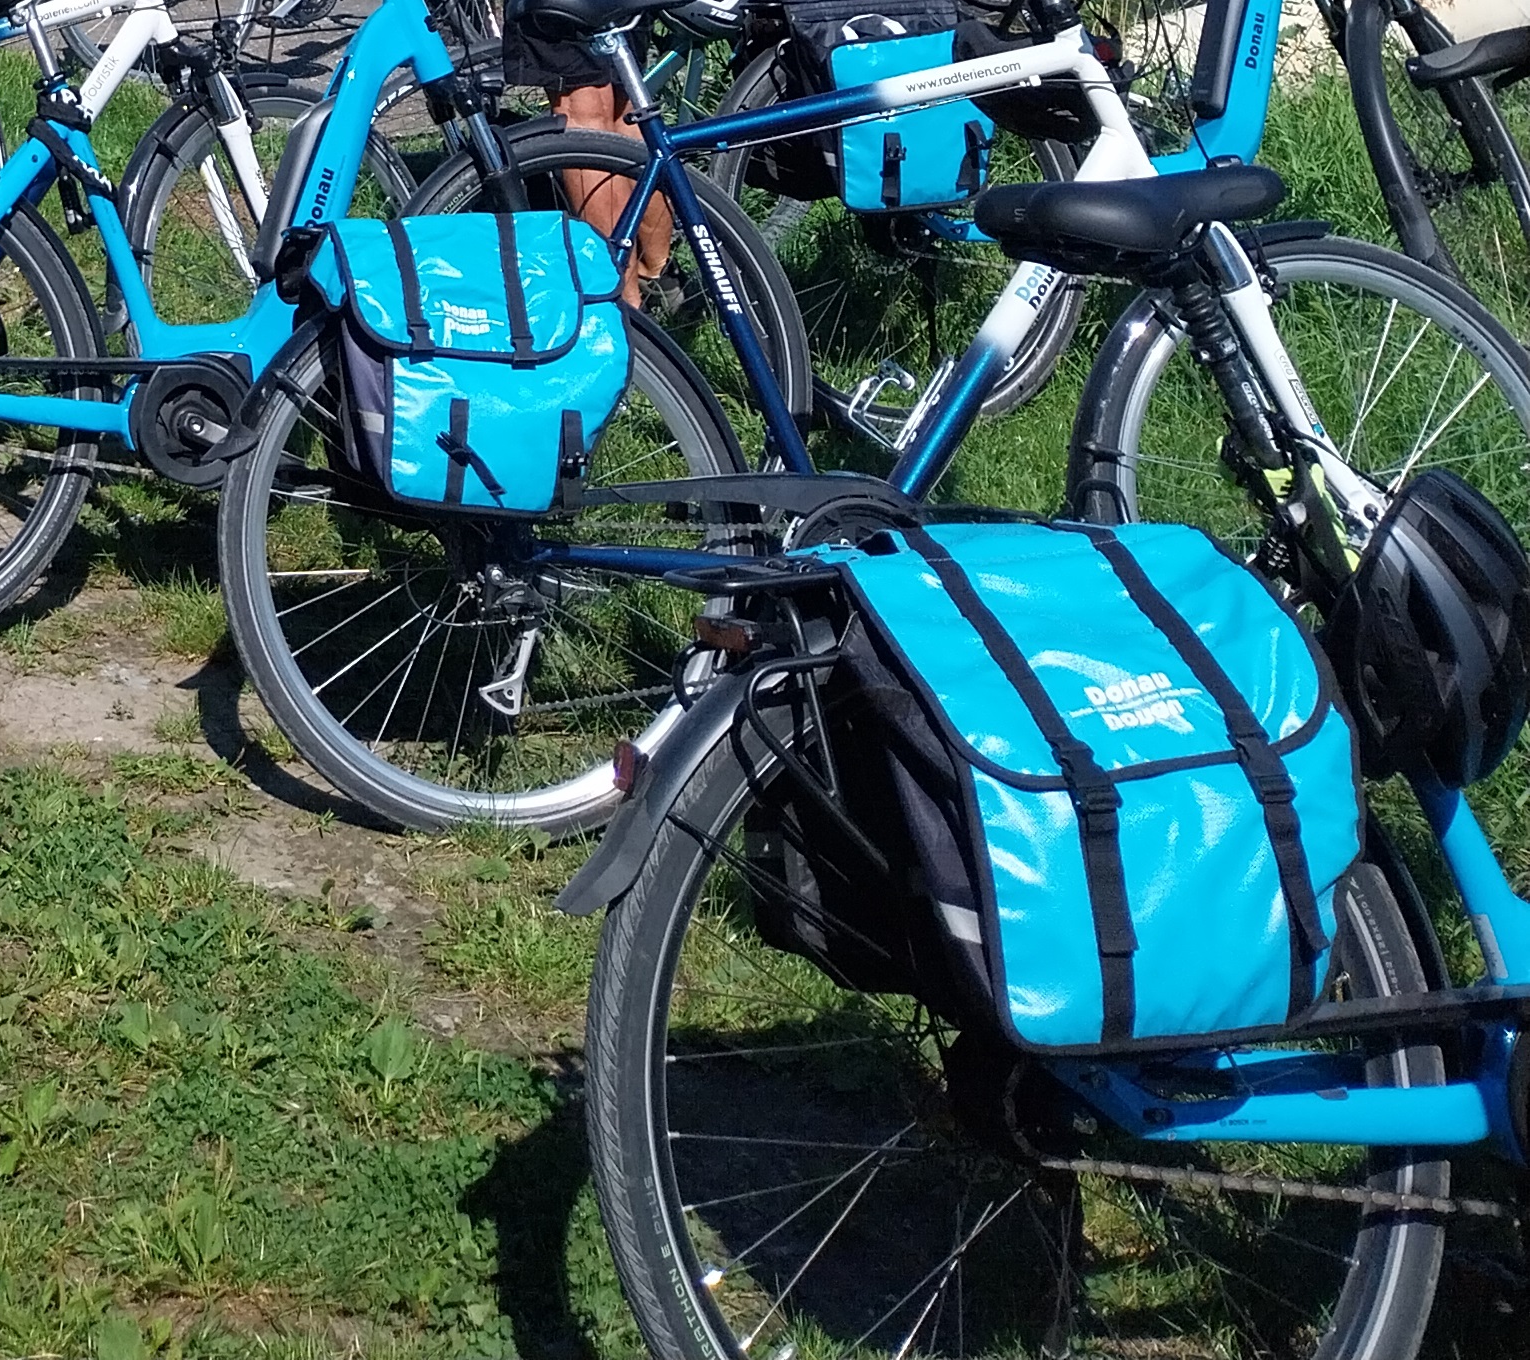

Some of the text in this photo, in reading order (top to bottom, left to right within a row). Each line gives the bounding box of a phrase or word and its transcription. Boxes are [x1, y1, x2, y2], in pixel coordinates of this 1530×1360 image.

[1245, 12, 1268, 70] Donau
[82, 55, 120, 103] Touristik
[907, 61, 1022, 93] www.radferien.com
[692, 224, 743, 314] SCHAUFF
[1014, 265, 1047, 301] Don
[1083, 672, 1172, 706] Donau
